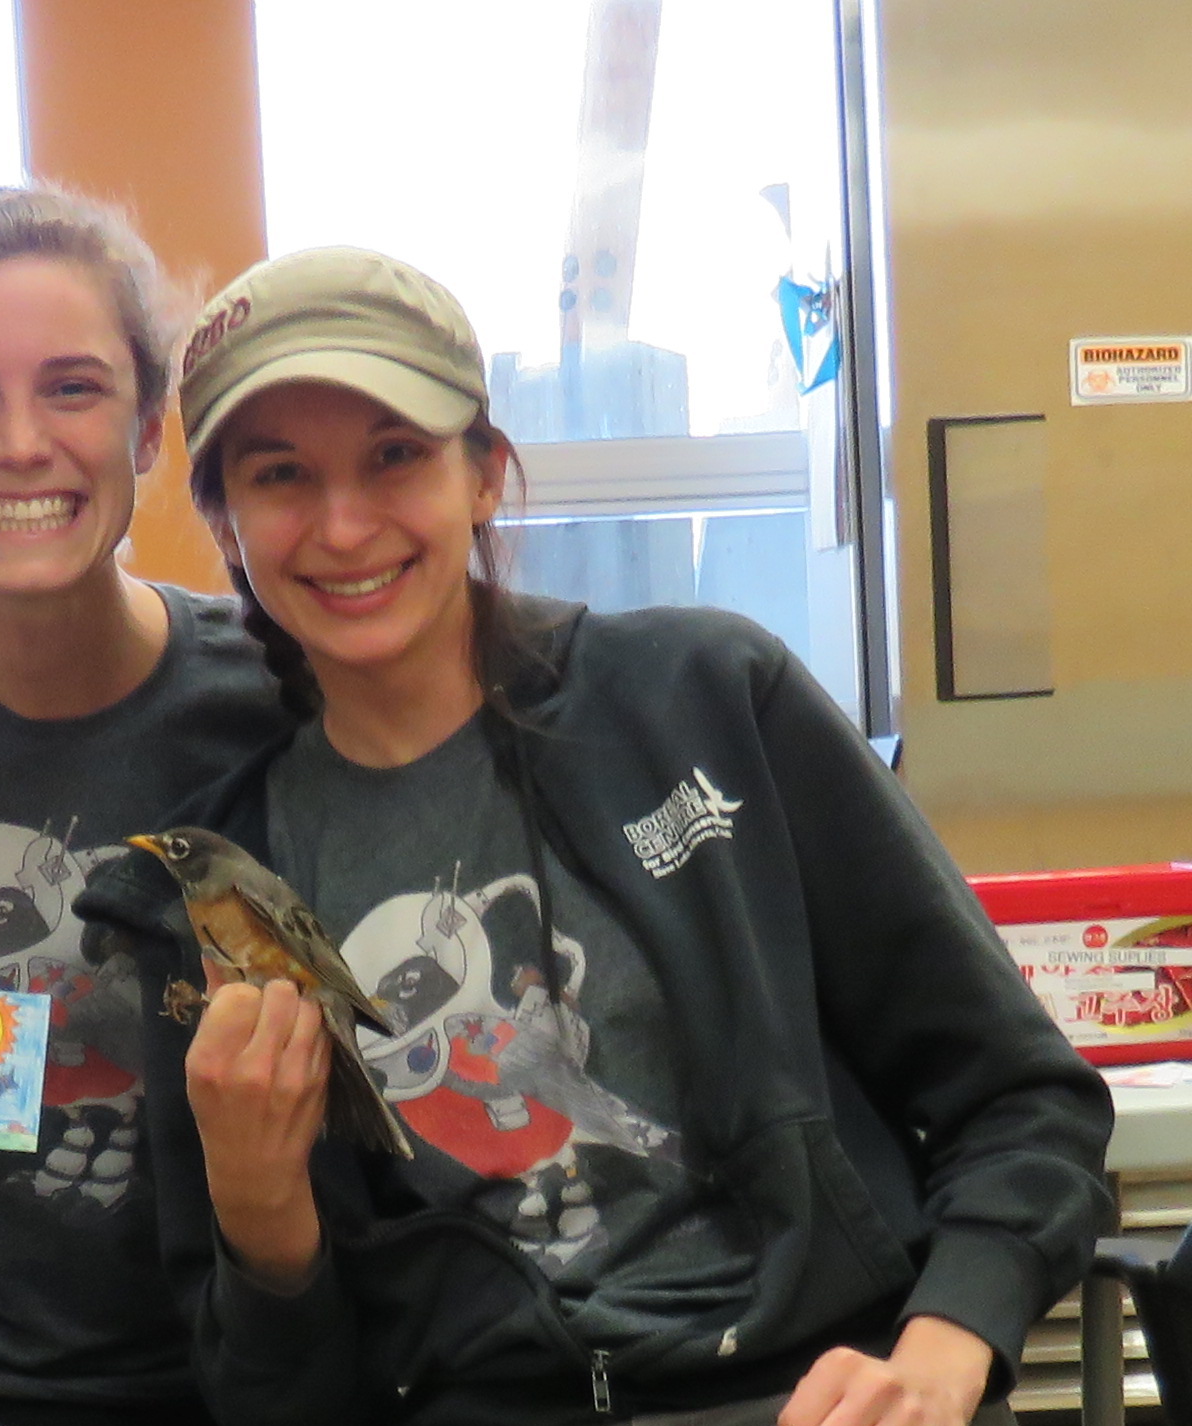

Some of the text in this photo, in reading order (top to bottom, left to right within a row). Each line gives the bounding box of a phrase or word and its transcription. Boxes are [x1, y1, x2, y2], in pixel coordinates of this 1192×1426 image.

[1084, 347, 1179, 363] BIOHAZARD
[622, 781, 698, 843] BOREAL
[633, 798, 707, 859] CENTRE
[1048, 951, 1104, 963] SEWING
